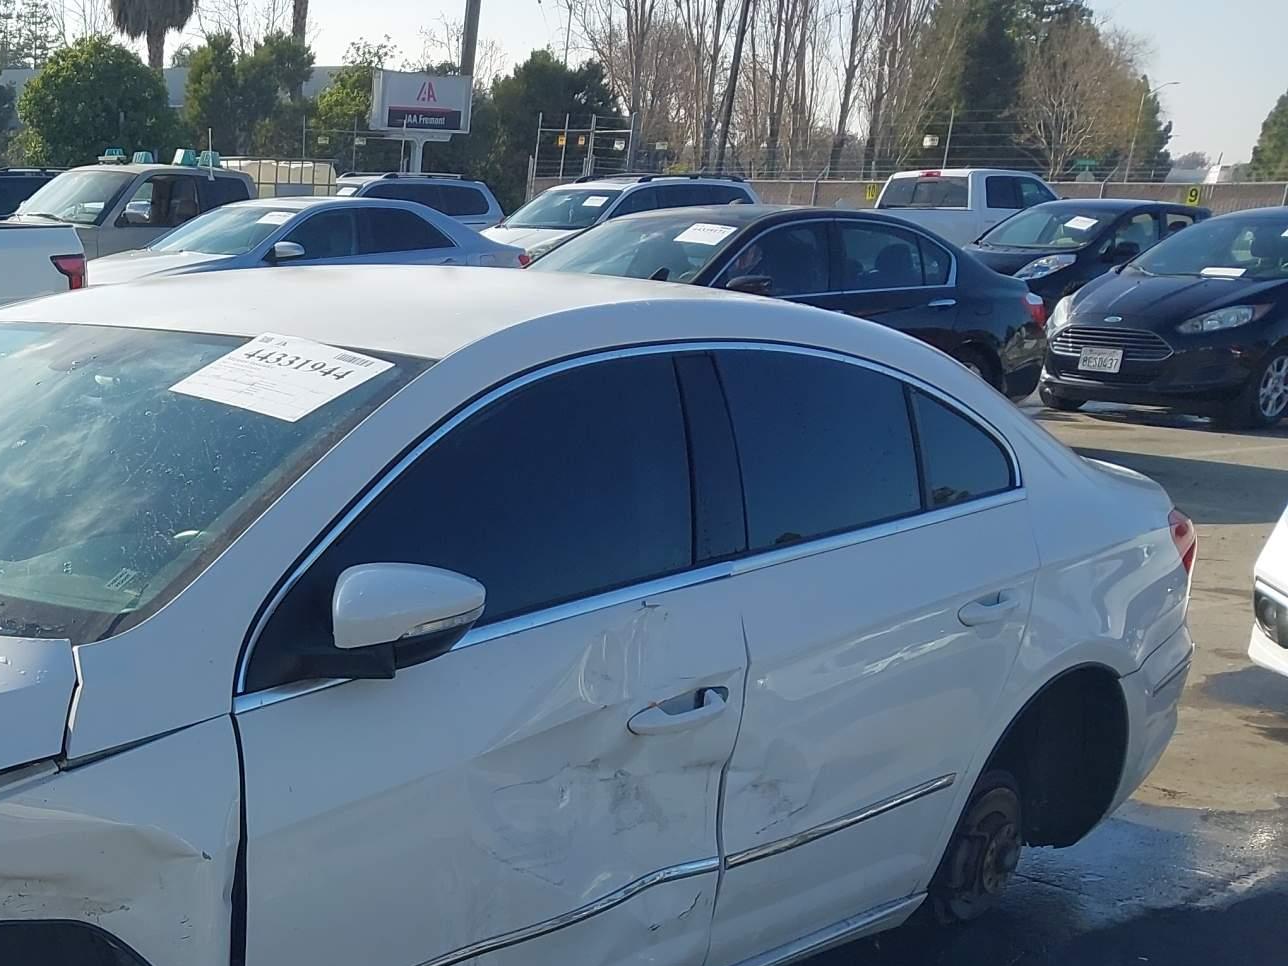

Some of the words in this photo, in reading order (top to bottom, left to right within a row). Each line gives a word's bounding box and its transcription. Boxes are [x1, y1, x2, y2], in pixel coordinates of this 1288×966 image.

[419, 114, 446, 125] Fremont
[1189, 188, 1198, 203] 9
[244, 349, 354, 381] 44331944
